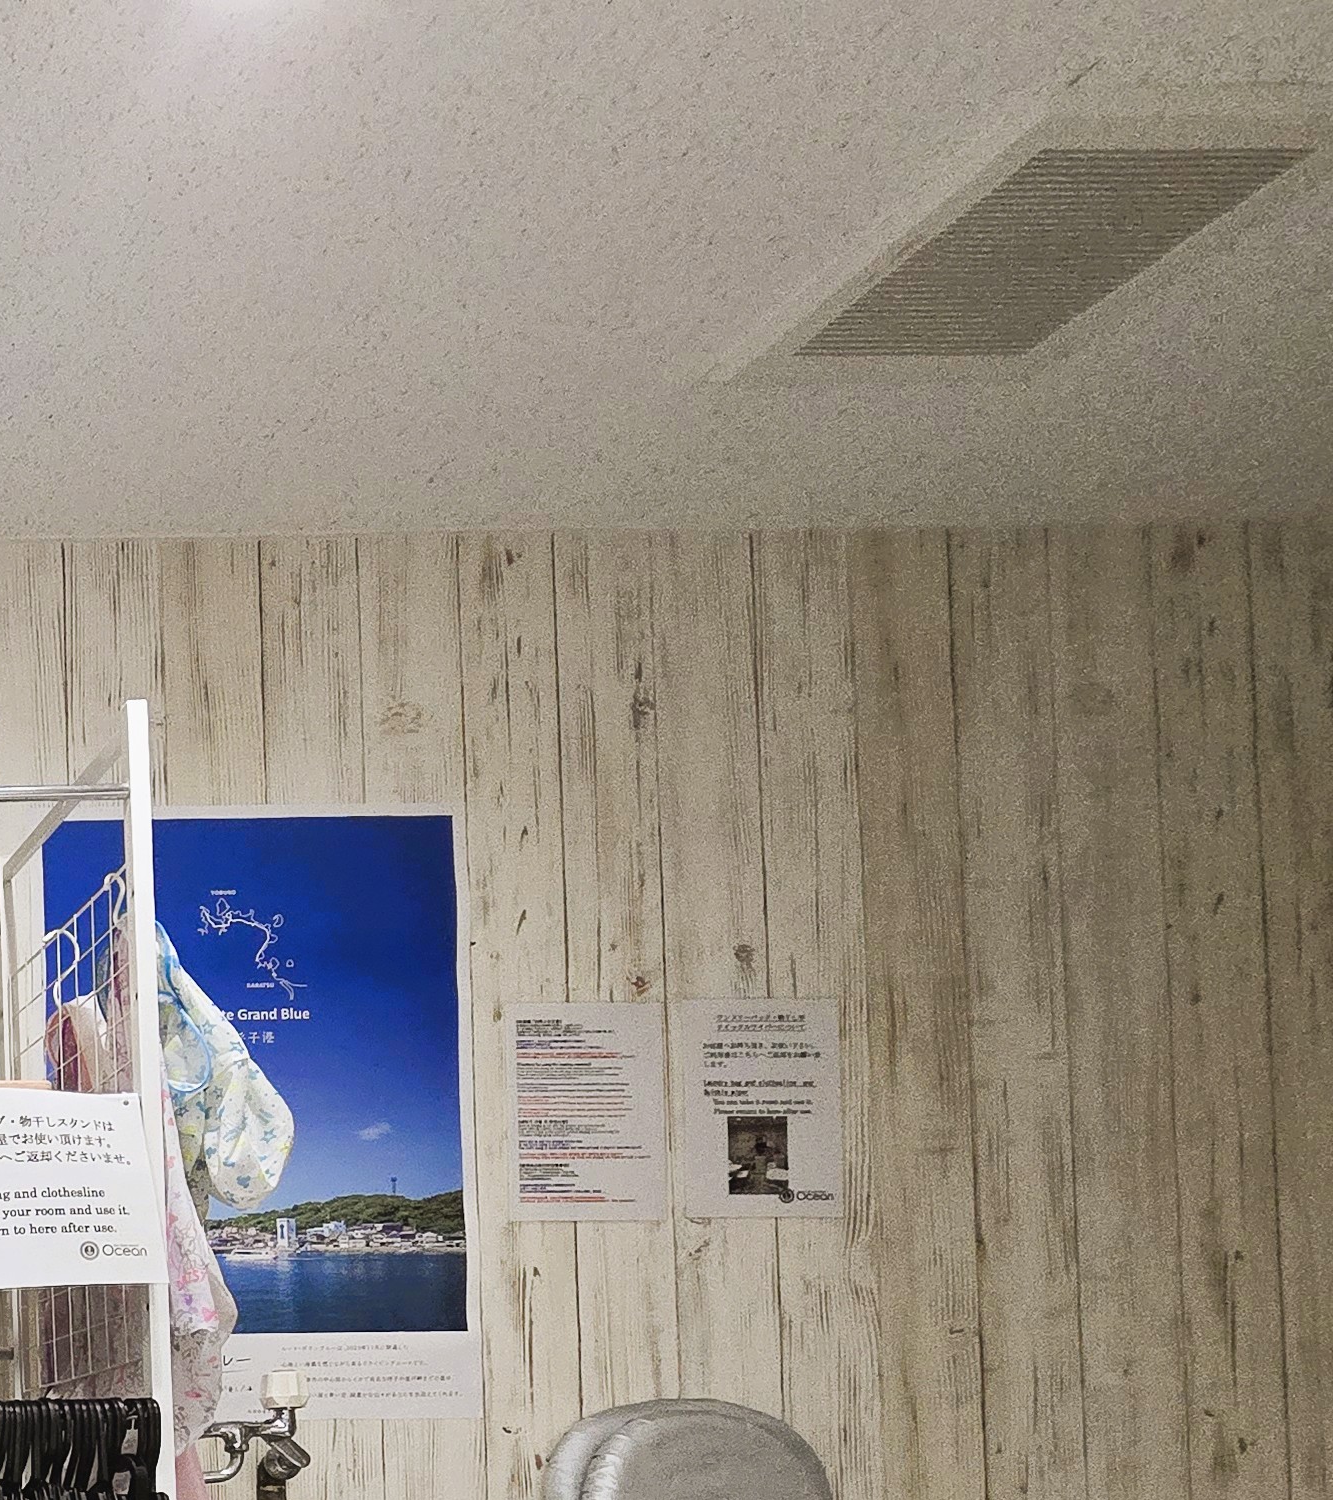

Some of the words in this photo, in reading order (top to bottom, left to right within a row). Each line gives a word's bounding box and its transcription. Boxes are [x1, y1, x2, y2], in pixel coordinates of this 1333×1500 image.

[237, 1008, 278, 1021] Grand
[281, 1008, 311, 1021] Blue
[14, 1187, 38, 1200] and
[41, 1186, 106, 1199] clothesline
[2, 1209, 32, 1222] your
[35, 1207, 67, 1218] room
[70, 1205, 92, 1216] and
[95, 1206, 116, 1216] use
[13, 1224, 26, 1236] to
[30, 1223, 58, 1235] here
[61, 1221, 90, 1234] after
[102, 1244, 148, 1257] Ocean
